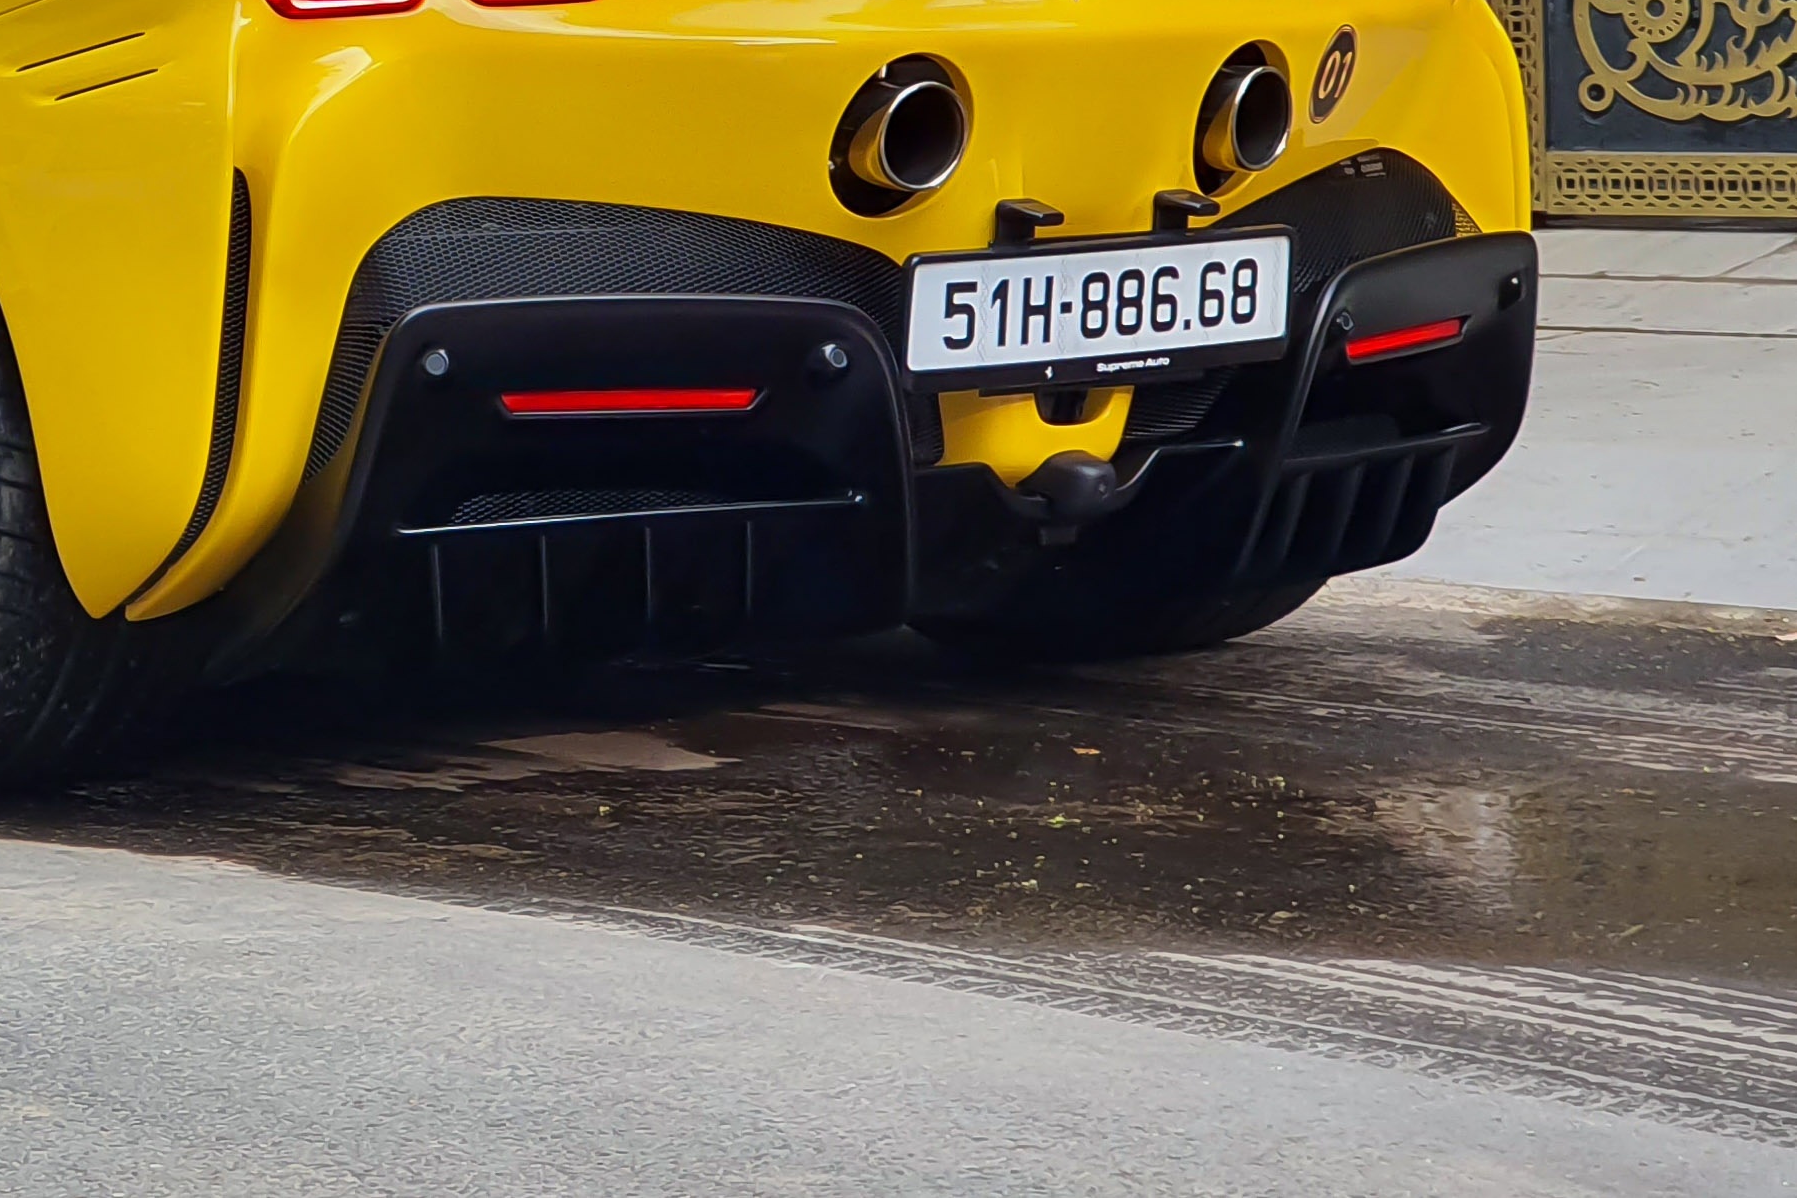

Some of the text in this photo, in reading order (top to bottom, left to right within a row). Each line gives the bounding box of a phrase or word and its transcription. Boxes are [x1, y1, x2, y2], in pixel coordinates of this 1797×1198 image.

[1318, 50, 1353, 99] 01
[943, 258, 1259, 350] 51H-886.68
[1096, 358, 1170, 372] Supreme Auto
